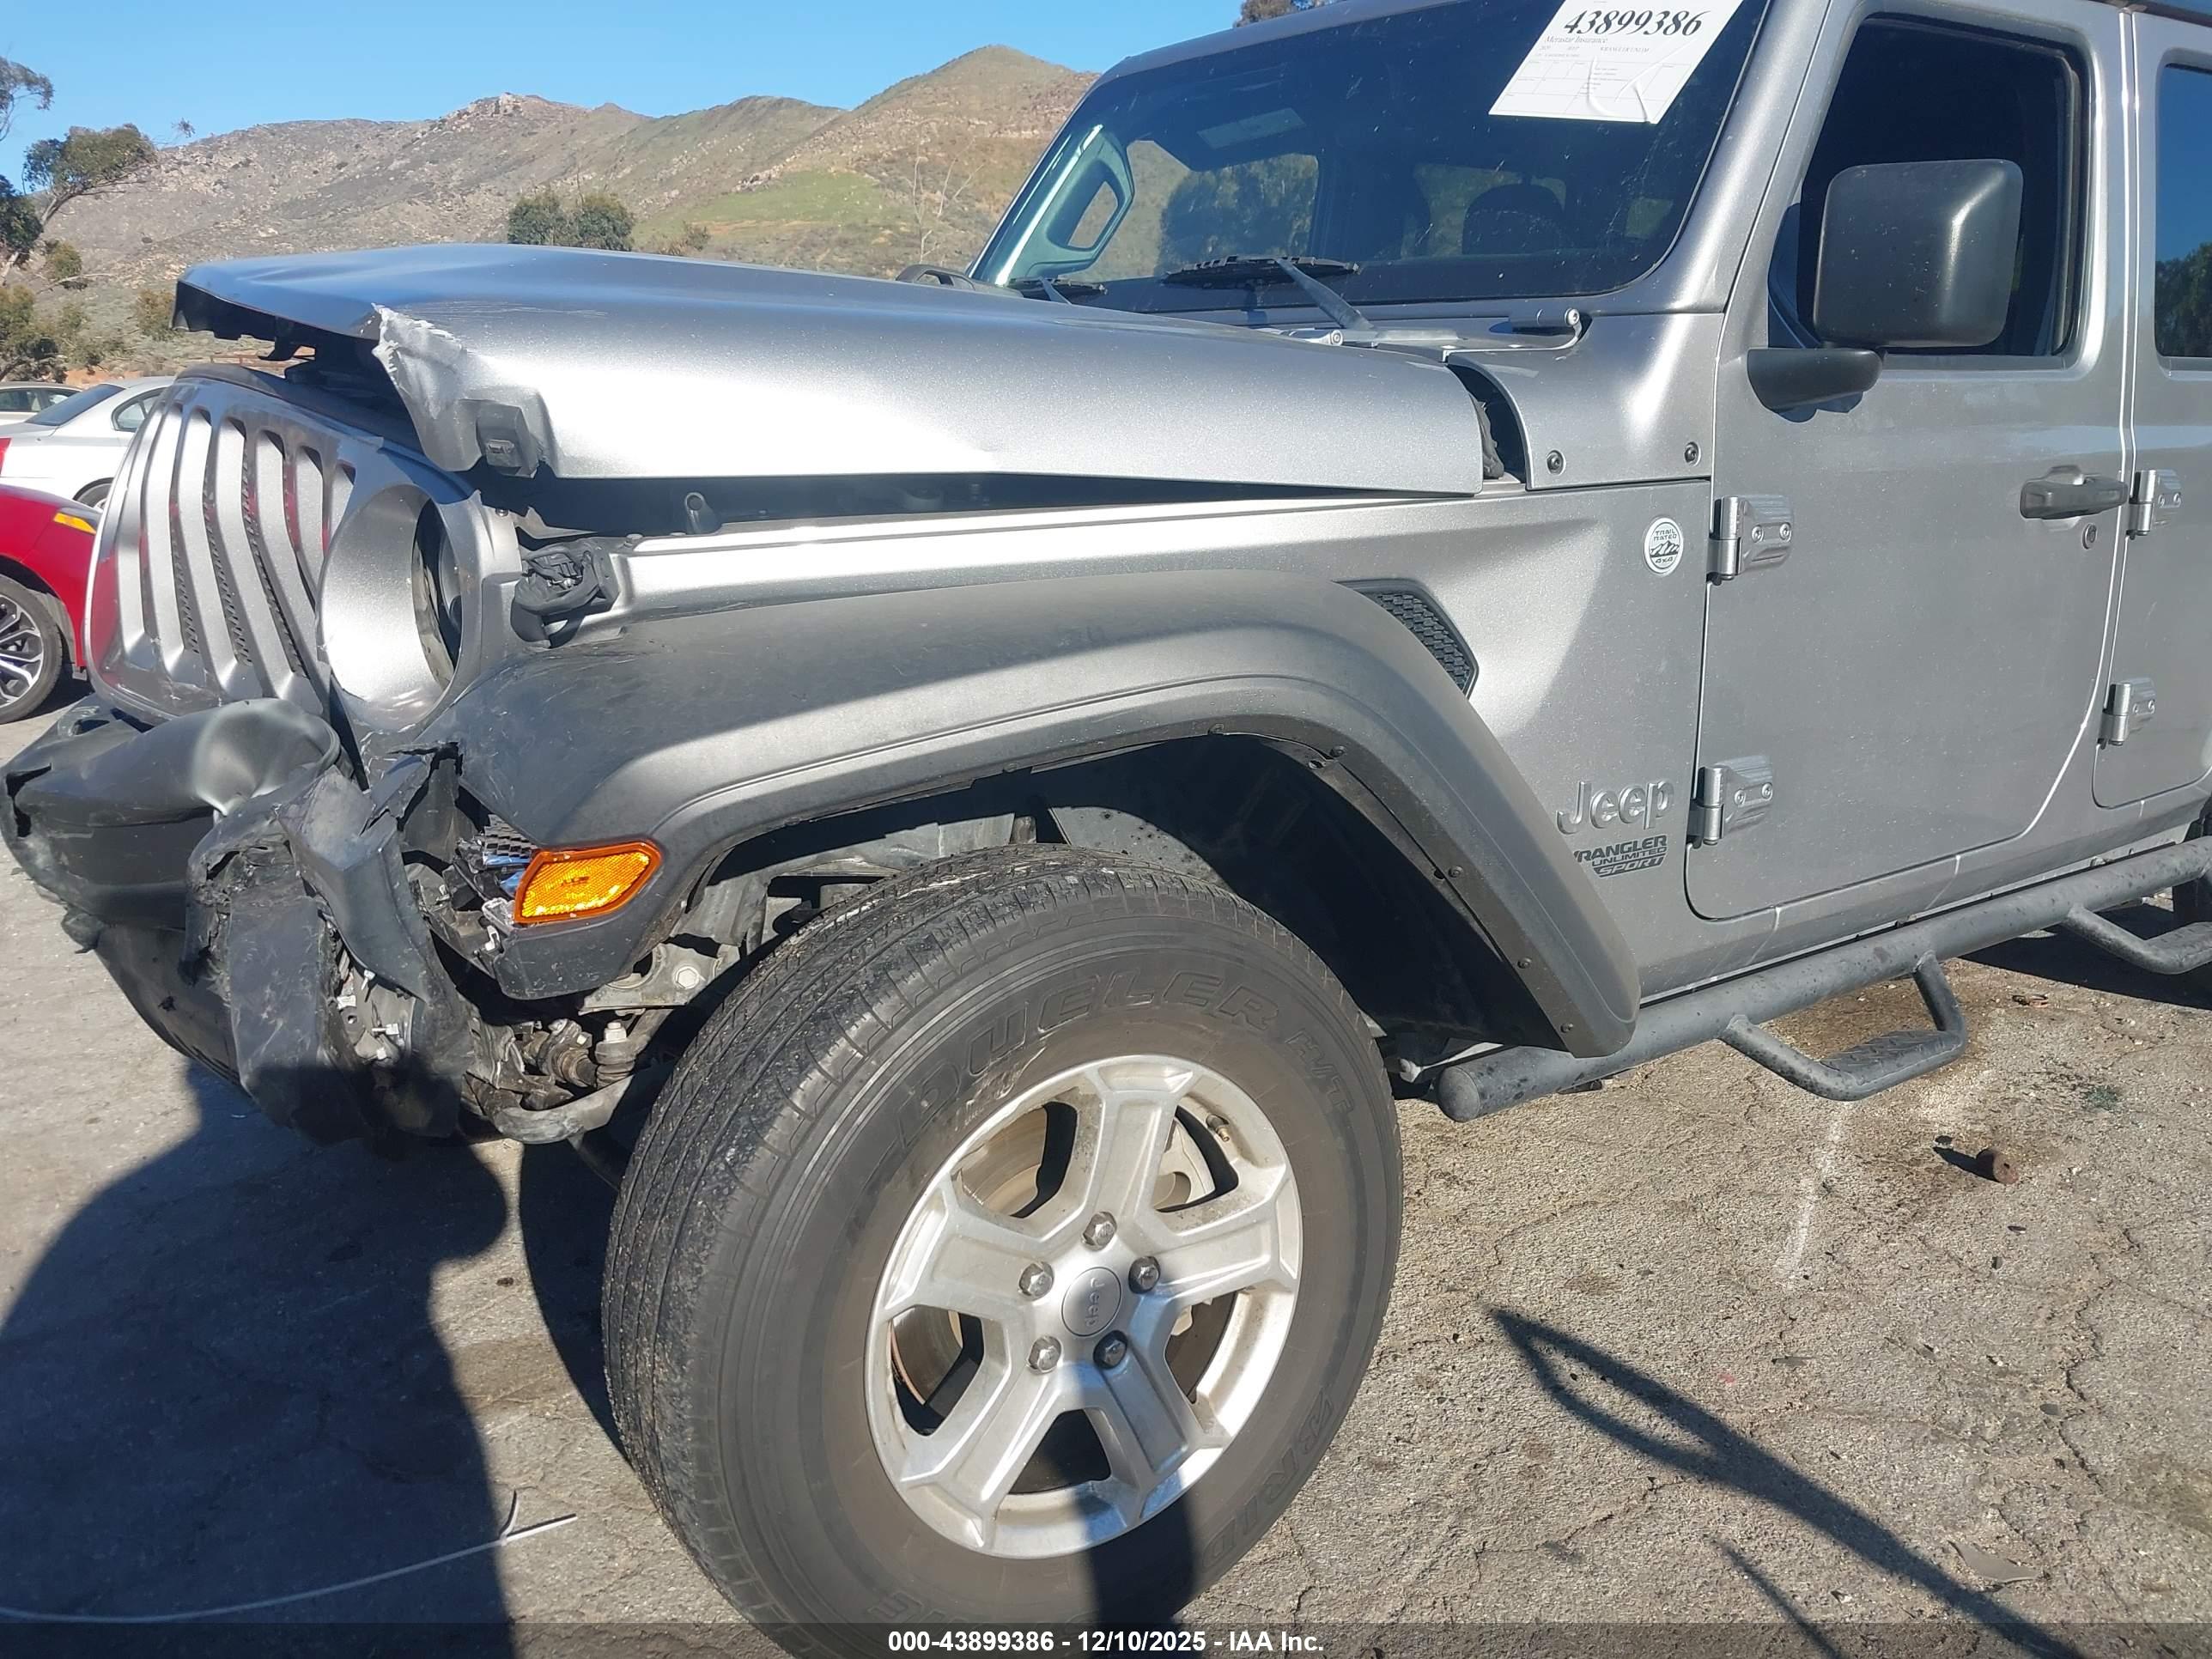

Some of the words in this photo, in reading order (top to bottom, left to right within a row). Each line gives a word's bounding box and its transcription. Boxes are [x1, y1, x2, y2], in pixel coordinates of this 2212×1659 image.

[1564, 9, 1711, 36] 43899386
[1556, 780, 1674, 836] Jeep
[1592, 847, 1668, 866] UNLIMITED
[1598, 856, 1665, 875] SPORT
[897, 969, 1279, 1151] DUELER
[1085, 1276, 1105, 1327] Jeep
